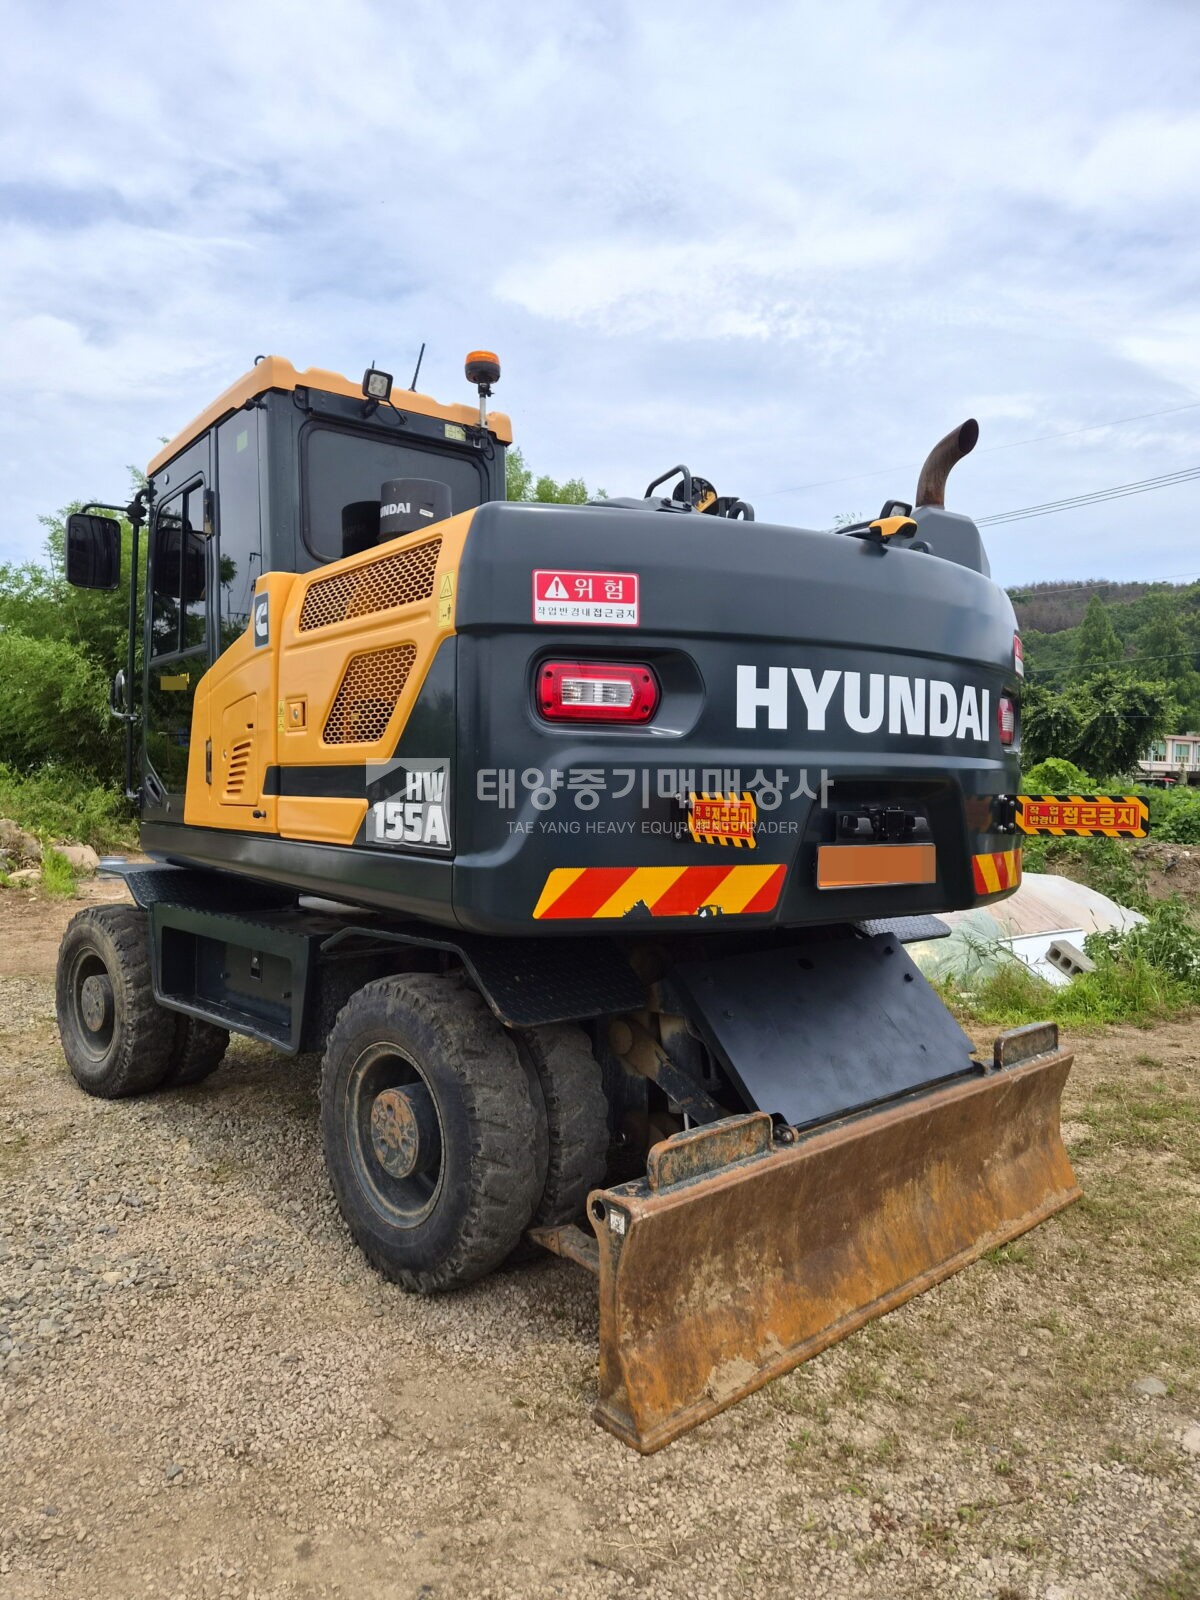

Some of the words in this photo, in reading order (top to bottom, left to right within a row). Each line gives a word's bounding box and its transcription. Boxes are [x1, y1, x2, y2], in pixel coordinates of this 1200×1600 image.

[736, 665, 990, 742] HYUNDAI
[406, 772, 445, 802] HW
[373, 801, 447, 845] 155A
[1029, 815, 1059, 825] 반경내
[1062, 806, 1135, 826] 접근금지
